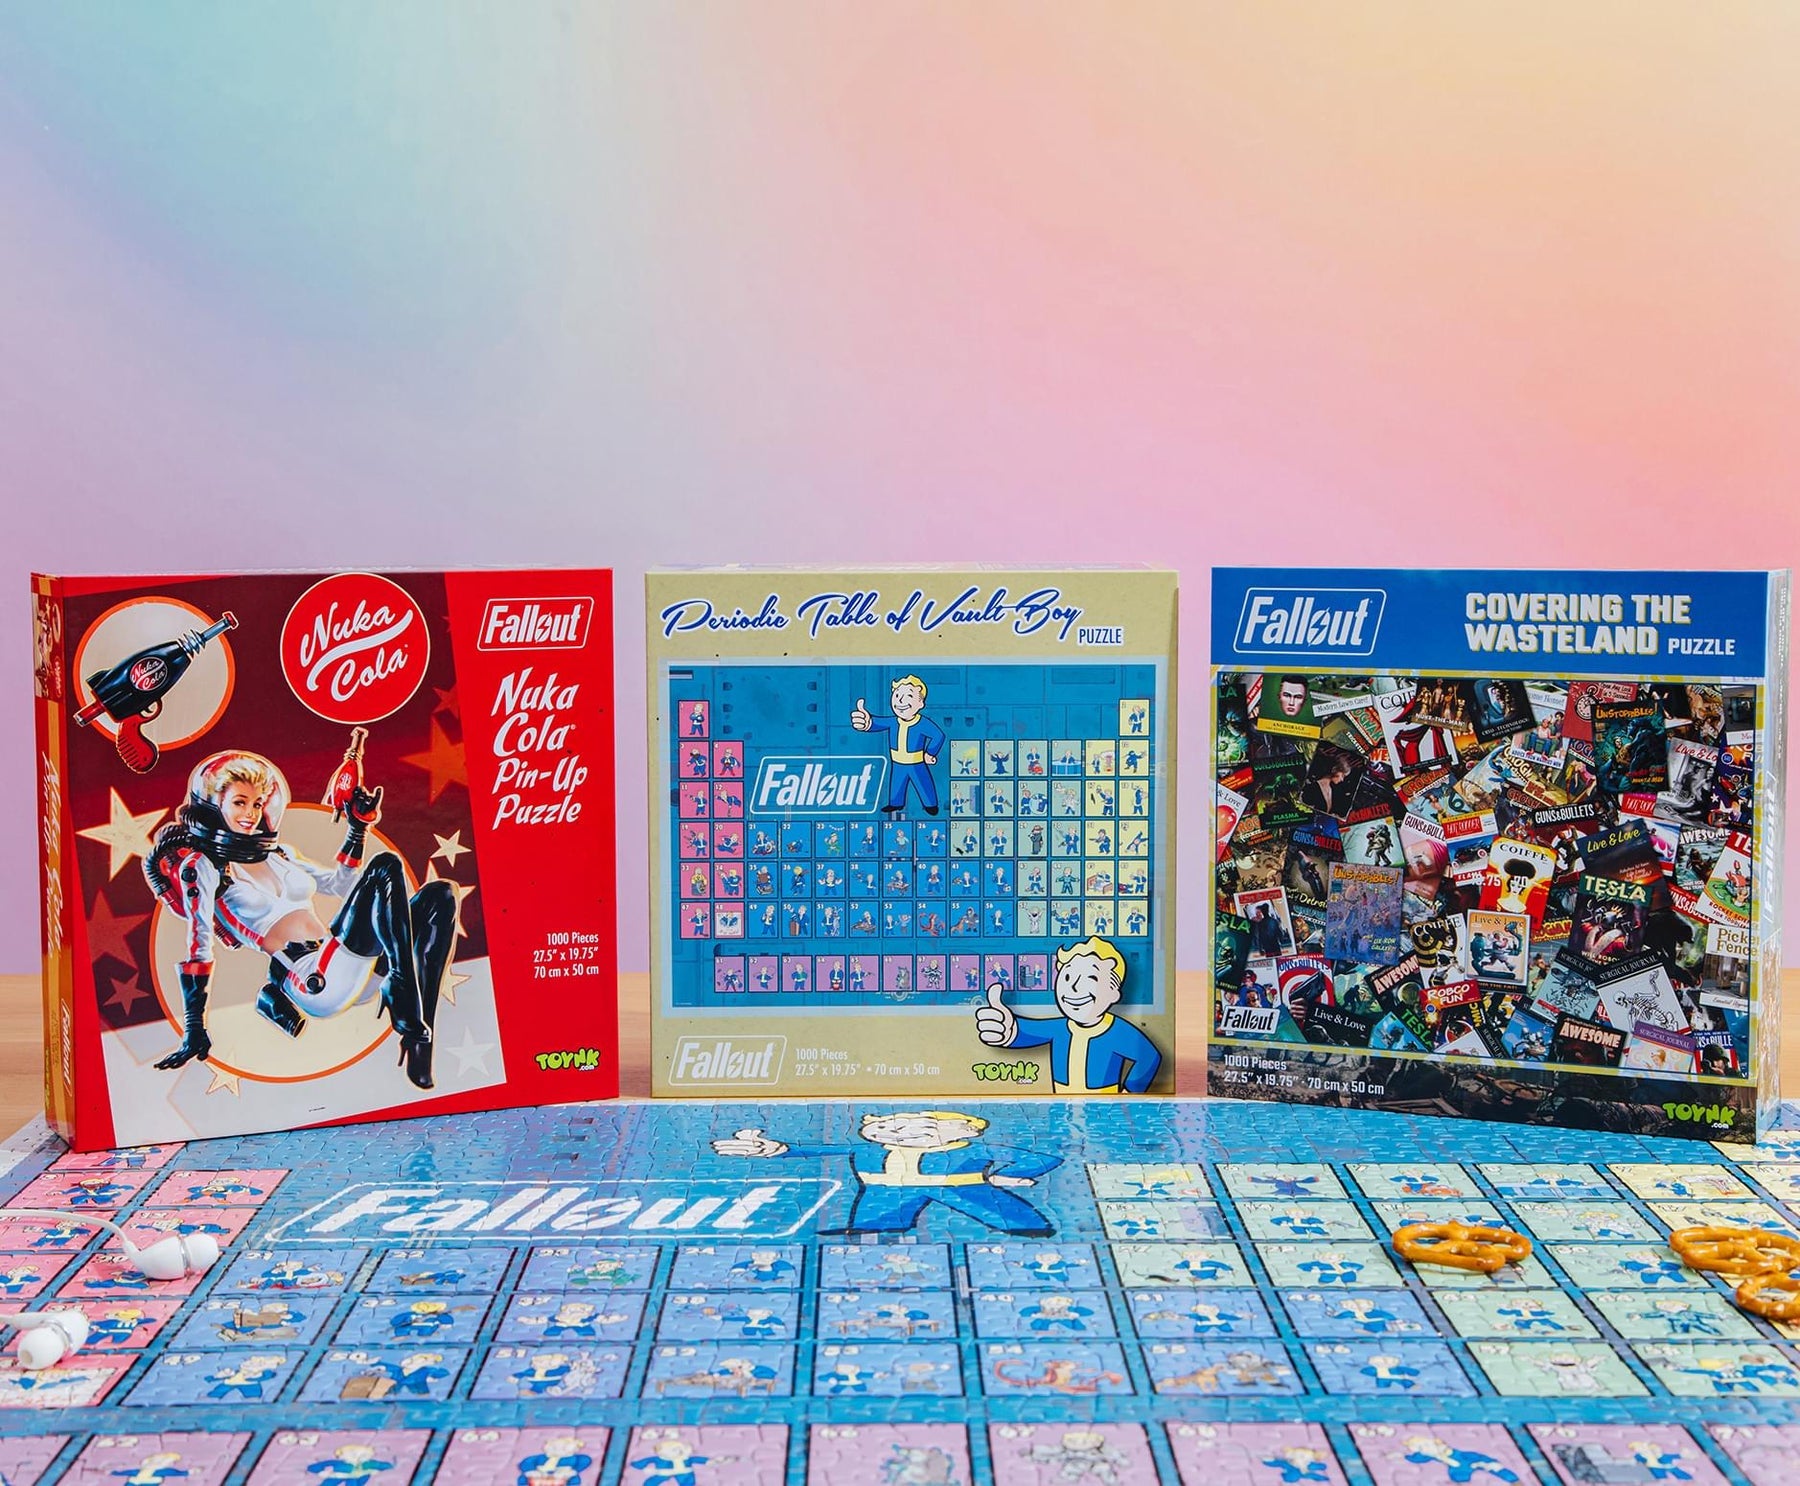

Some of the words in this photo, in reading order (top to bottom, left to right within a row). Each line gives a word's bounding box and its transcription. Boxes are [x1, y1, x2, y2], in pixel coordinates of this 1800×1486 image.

[661, 594, 791, 640] Periodic
[797, 591, 879, 640] Table
[884, 589, 923, 633] of
[918, 587, 1010, 632] Vault
[1010, 586, 1082, 641] Boy
[1077, 627, 1123, 646] PUZZLE
[1465, 591, 1625, 623] COVERING
[1630, 593, 1692, 625] THE
[484, 603, 583, 645] Fallout
[1242, 595, 1371, 647] Fallout
[300, 599, 397, 668] Nuka
[1463, 623, 1660, 656] WASTELAND
[1667, 637, 1736, 657] PUZZLE
[131, 660, 160, 684] Nuka
[142, 669, 166, 691] Cola
[330, 645, 409, 702] Cola
[490, 666, 581, 717] Nuka
[492, 712, 570, 758] Cola
[1674, 742, 1696, 757] Live
[1697, 747, 1706, 760] &
[490, 754, 589, 795] Pin-Up
[758, 762, 874, 808] Fallout
[1224, 792, 1242, 808] Love
[491, 794, 583, 831] Puzzle
[1273, 812, 1299, 821] PLASMA
[1534, 803, 1595, 824] GUNS&BULLETS
[1586, 840, 1608, 853] Live
[1608, 832, 1617, 847] &
[1617, 828, 1641, 843] Love
[1499, 843, 1549, 863] COIFFE
[1584, 875, 1647, 903] TESLA
[547, 932, 569, 946] 1000
[571, 931, 599, 944] Pieces
[559, 951, 566, 961] x
[1599, 965, 1629, 980] SURGICAL
[1629, 954, 1658, 970] JOURNAL
[534, 965, 546, 979] 70
[548, 967, 561, 978] cm
[563, 967, 570, 977] x
[572, 964, 584, 976] 50
[586, 965, 599, 975] cm
[1427, 983, 1471, 1000] ROBCO
[1440, 993, 1464, 1005] FUN
[1222, 1007, 1275, 1031] Fallout
[1314, 1007, 1333, 1021] Live
[1333, 1014, 1343, 1026] &
[1343, 1016, 1367, 1032] Love
[1559, 1021, 1622, 1049] AWESOME
[1639, 1027, 1667, 1042] SURGICAL
[1667, 1034, 1690, 1049] JOURNAL
[534, 1047, 600, 1070] TOYNK
[674, 1041, 776, 1080] Fallout
[795, 1047, 819, 1061] 1000
[820, 1047, 849, 1061] Pieces
[1223, 1053, 1250, 1068] 1000
[1251, 1056, 1288, 1072] Pieces
[874, 1062, 888, 1076] 70
[889, 1065, 903, 1076] cm
[912, 1062, 926, 1076] 50
[927, 1065, 940, 1076] cm
[971, 1061, 1040, 1081] TOYNK
[1256, 1074, 1263, 1085] x
[1307, 1077, 1322, 1090] 70
[1323, 1080, 1341, 1092] cm
[1342, 1082, 1349, 1092] x
[1350, 1080, 1366, 1094] 50
[1367, 1083, 1385, 1096] cm
[1662, 1101, 1737, 1127] TOYNK
[304, 1185, 785, 1233] Fallout
